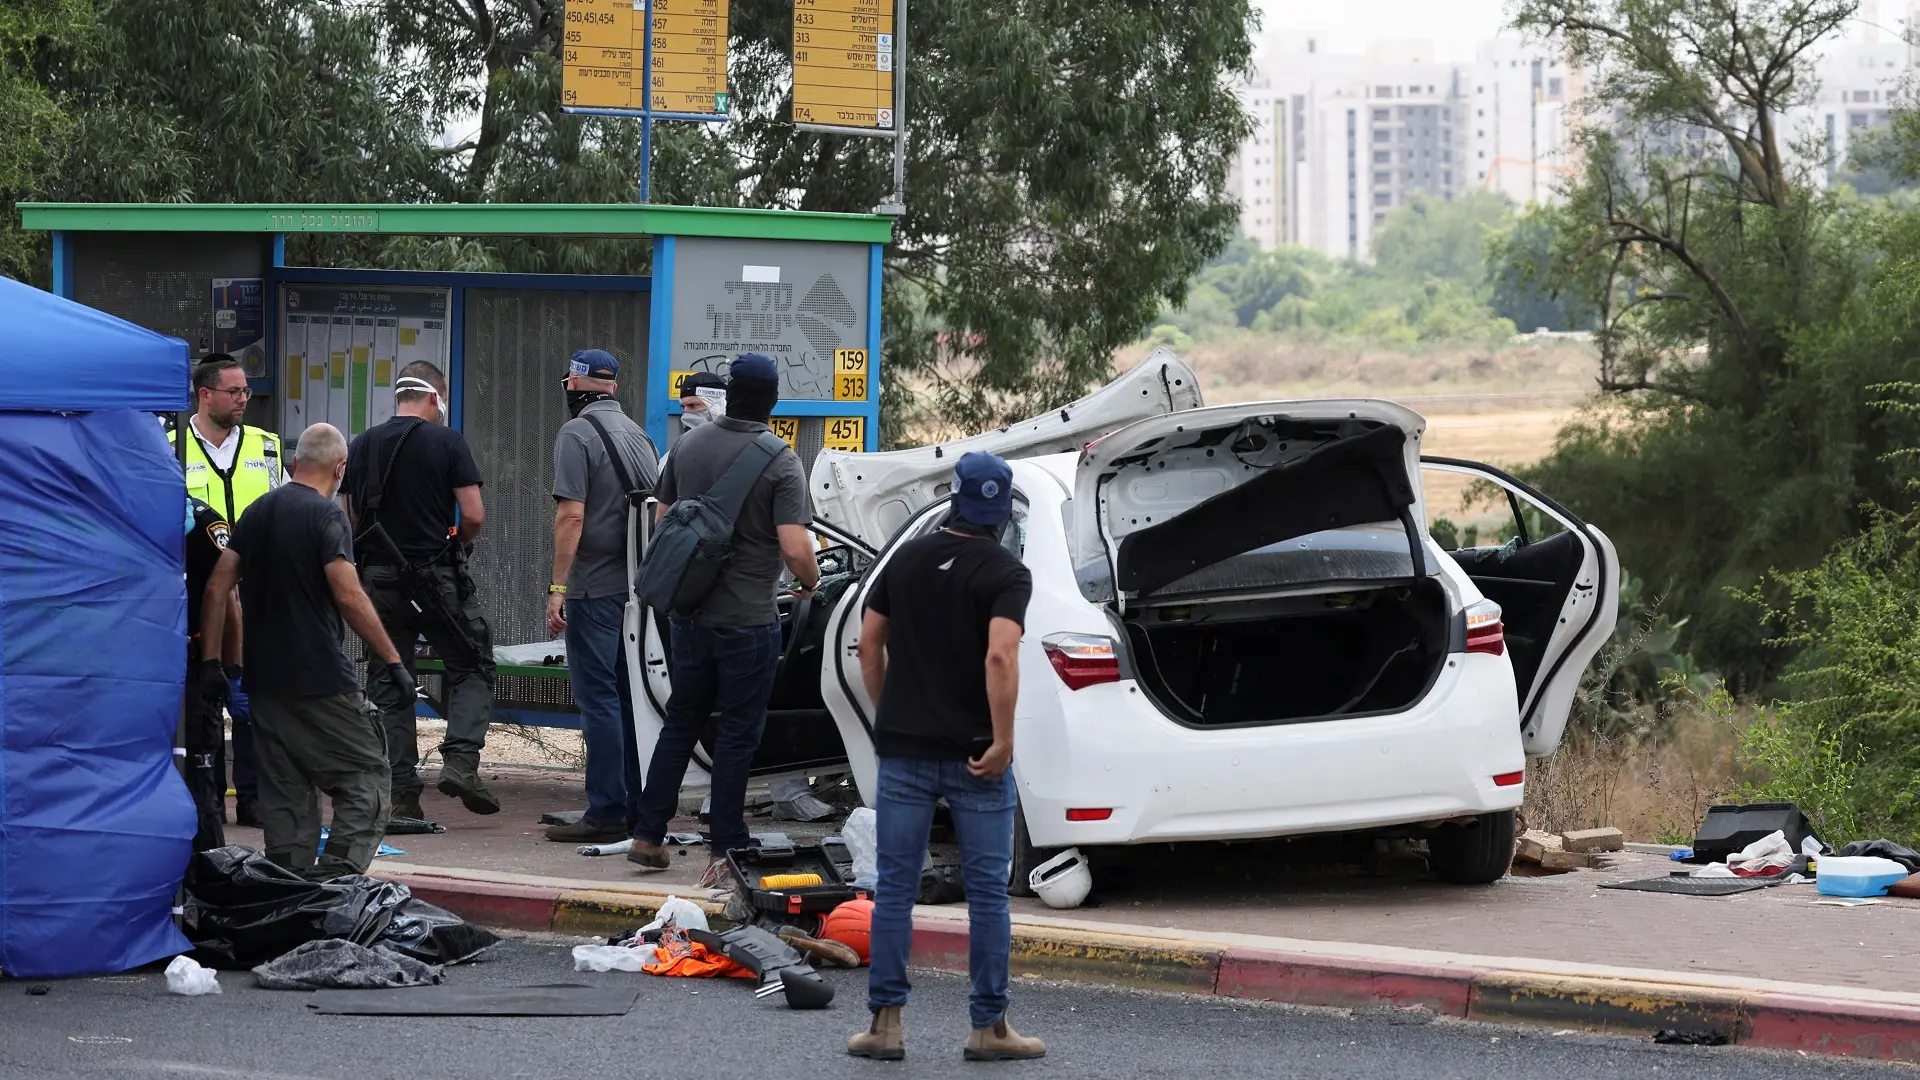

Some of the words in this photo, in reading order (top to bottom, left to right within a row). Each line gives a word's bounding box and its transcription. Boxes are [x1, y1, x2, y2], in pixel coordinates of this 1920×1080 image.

[653, 0, 668, 10] 452
[566, 11, 615, 26] 450,451,454
[652, 19, 667, 29] 457
[796, 13, 814, 24] 433
[852, 15, 877, 24] ירושלים
[565, 31, 581, 42] 455
[701, 37, 715, 45] רמלה
[796, 32, 810, 43] 313
[859, 34, 876, 43] רמלה
[652, 38, 666, 48] 458
[565, 50, 577, 61] 134
[707, 56, 715, 64] לוד
[795, 51, 808, 62] 411
[847, 52, 863, 60] שמש
[865, 53, 876, 61] בית
[652, 57, 664, 67] 461
[652, 77, 664, 87] 461
[564, 90, 577, 101] 154
[652, 96, 664, 106] 144
[795, 108, 811, 119] 174
[837, 111, 854, 120] בלבד
[856, 113, 876, 121] הורדה
[272, 215, 293, 229] דרך
[302, 214, 323, 227] בכל
[332, 213, 373, 227] להוביל
[724, 281, 793, 312] נתיבי
[706, 304, 792, 340] ישראל
[711, 342, 739, 351] לתשתיות
[741, 343, 768, 351] הלאומית
[840, 351, 864, 370] 159
[842, 377, 864, 398] 313
[772, 420, 794, 440] 154
[831, 420, 859, 439] 451
